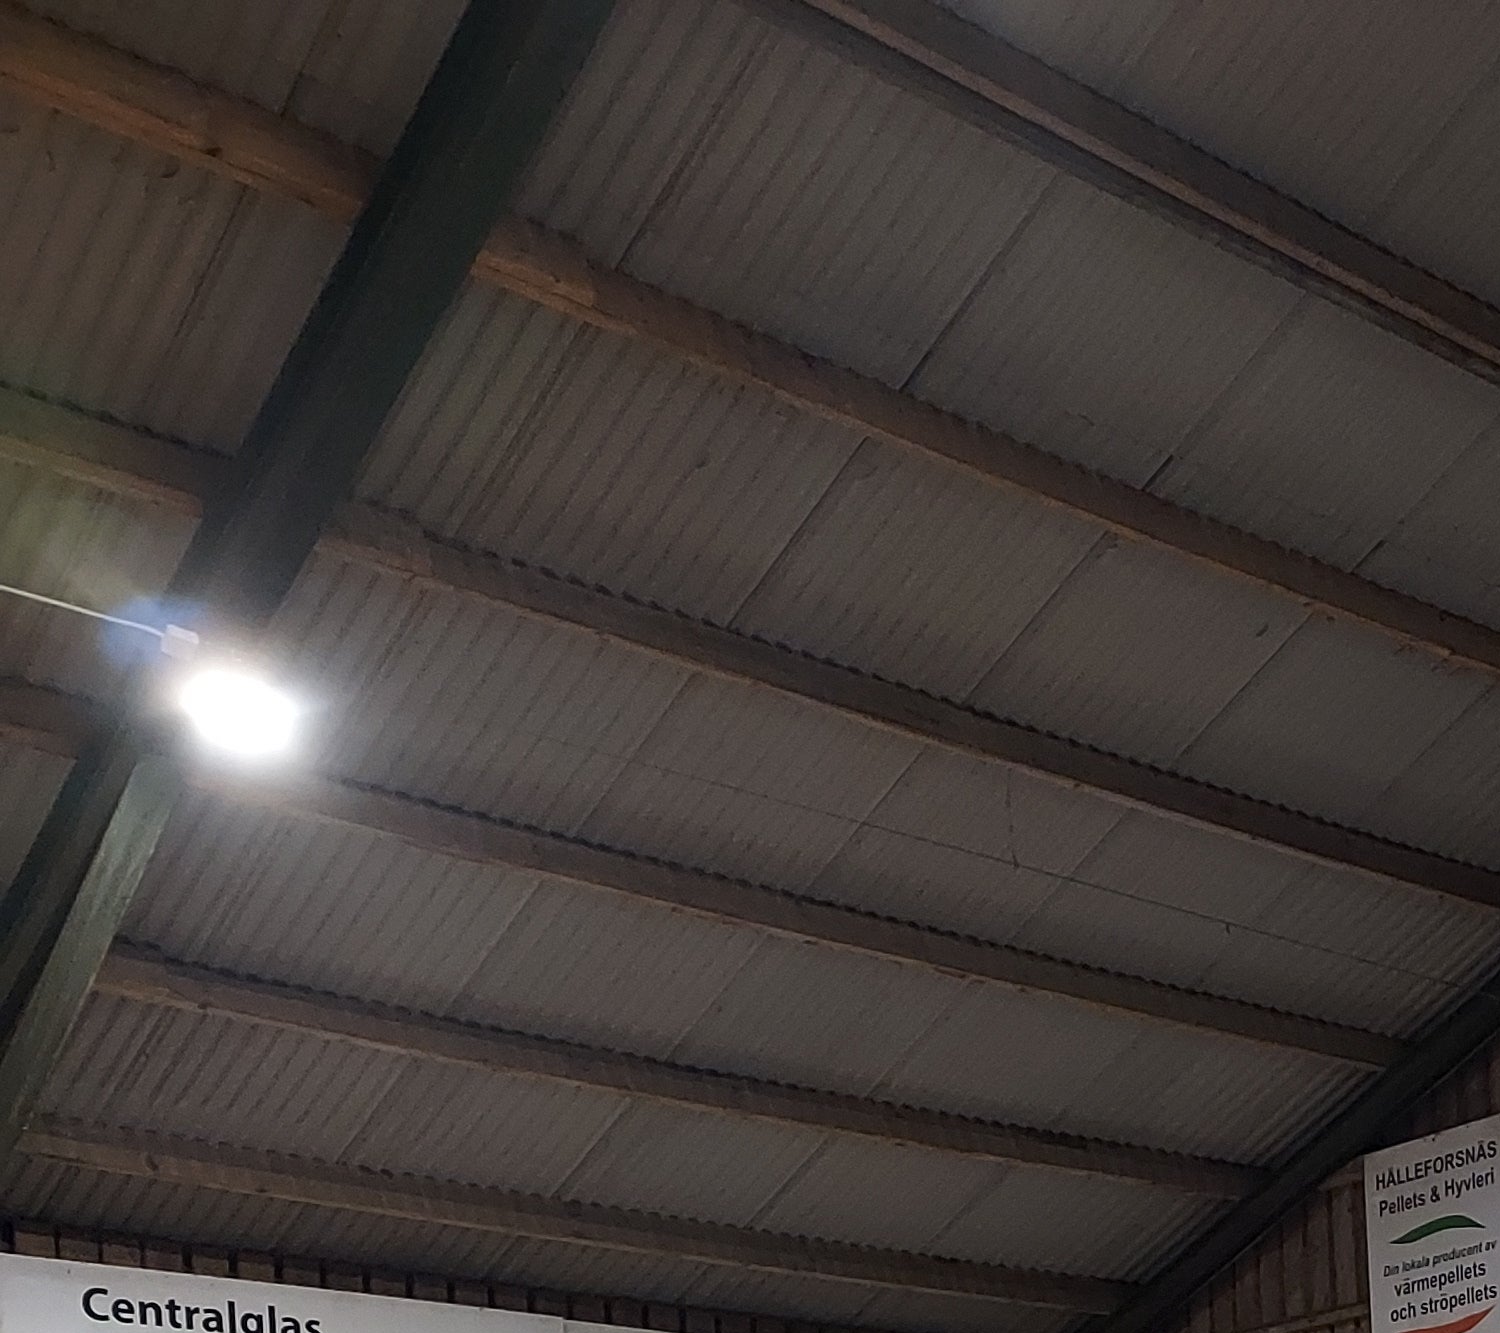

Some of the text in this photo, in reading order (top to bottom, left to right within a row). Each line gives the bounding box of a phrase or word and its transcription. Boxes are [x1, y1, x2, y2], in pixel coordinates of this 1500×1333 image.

[1375, 1140, 1498, 1191] HÄLLEFORSNÄS
[1379, 1167, 1494, 1217] Pellets & Hyvleri
[1383, 1240, 1497, 1277] Din lokala producent av
[1394, 1261, 1487, 1297] värmepellets
[1390, 1283, 1498, 1322] och ströpellets
